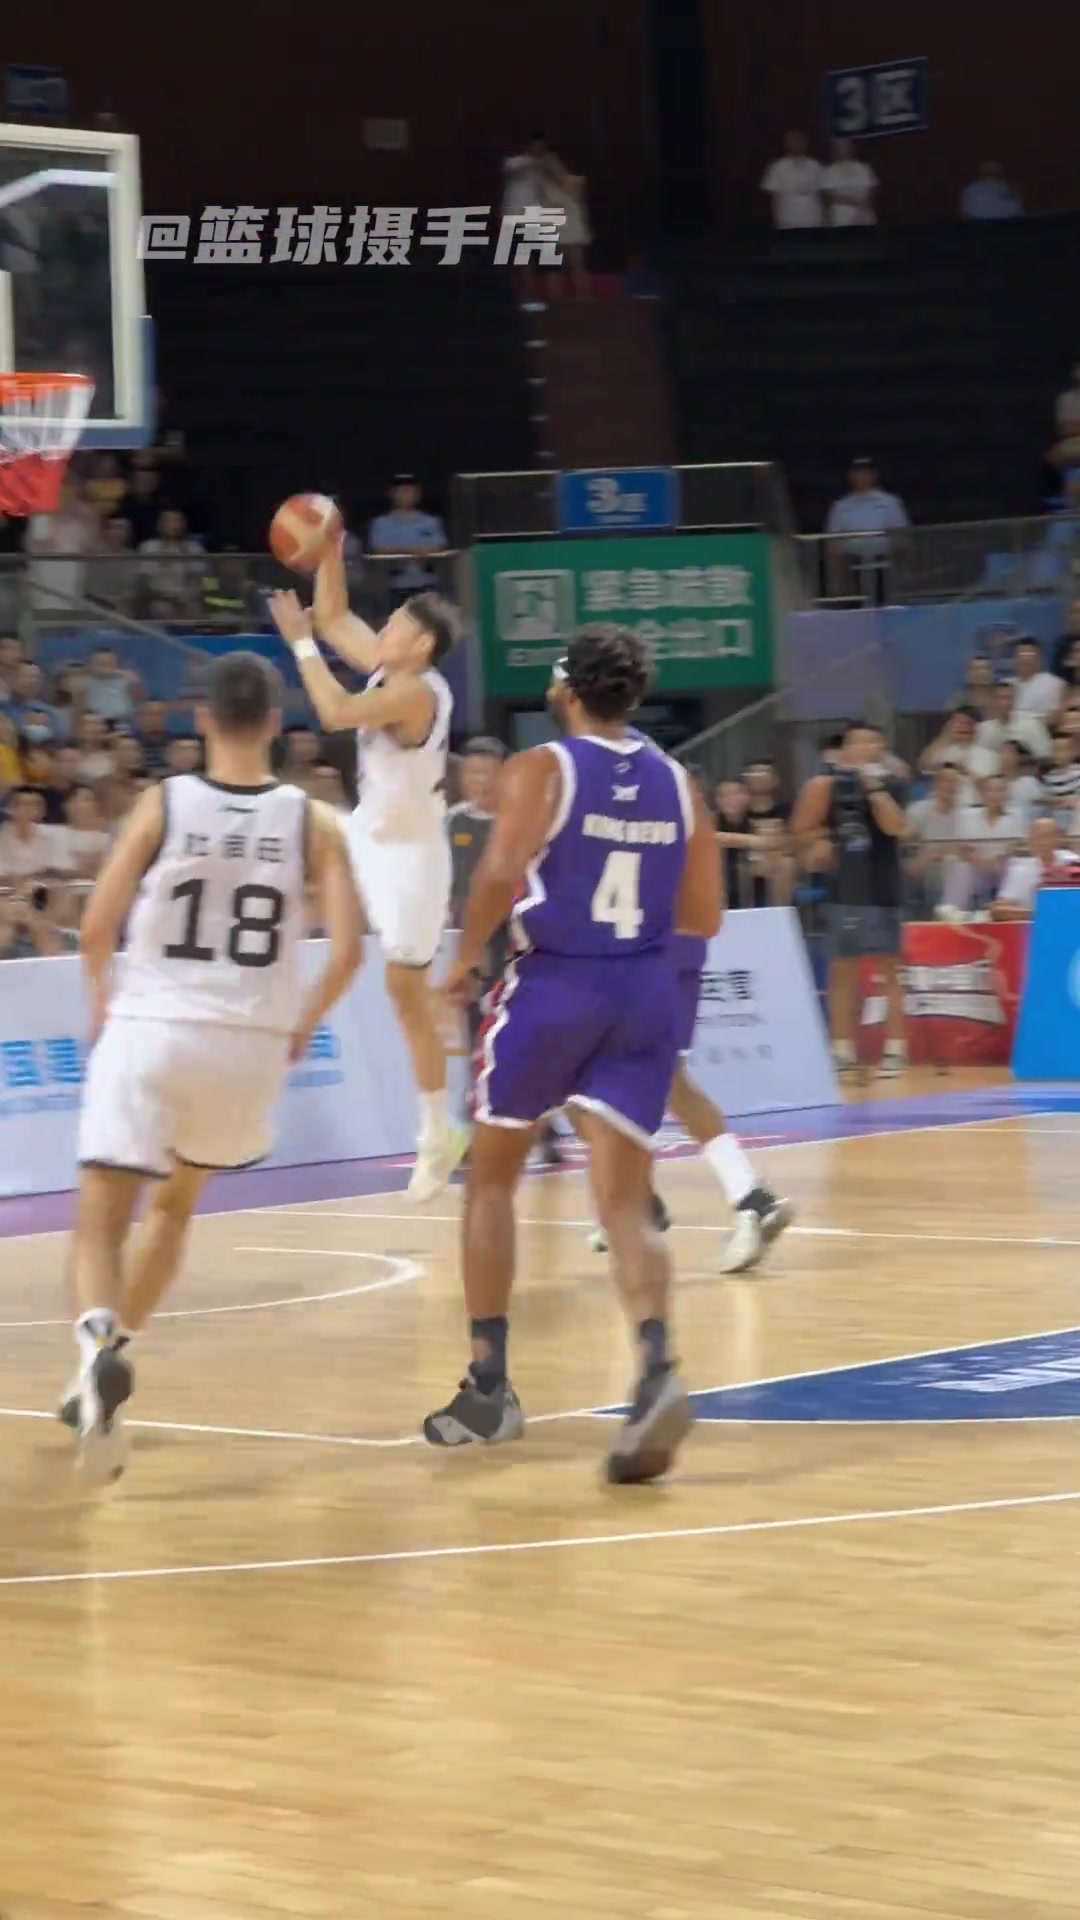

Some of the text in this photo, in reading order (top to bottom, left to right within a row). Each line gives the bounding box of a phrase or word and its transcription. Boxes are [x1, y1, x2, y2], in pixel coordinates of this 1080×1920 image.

[834, 68, 920, 133] 3区
[164, 878, 285, 967] 18
[591, 849, 645, 939] 4
